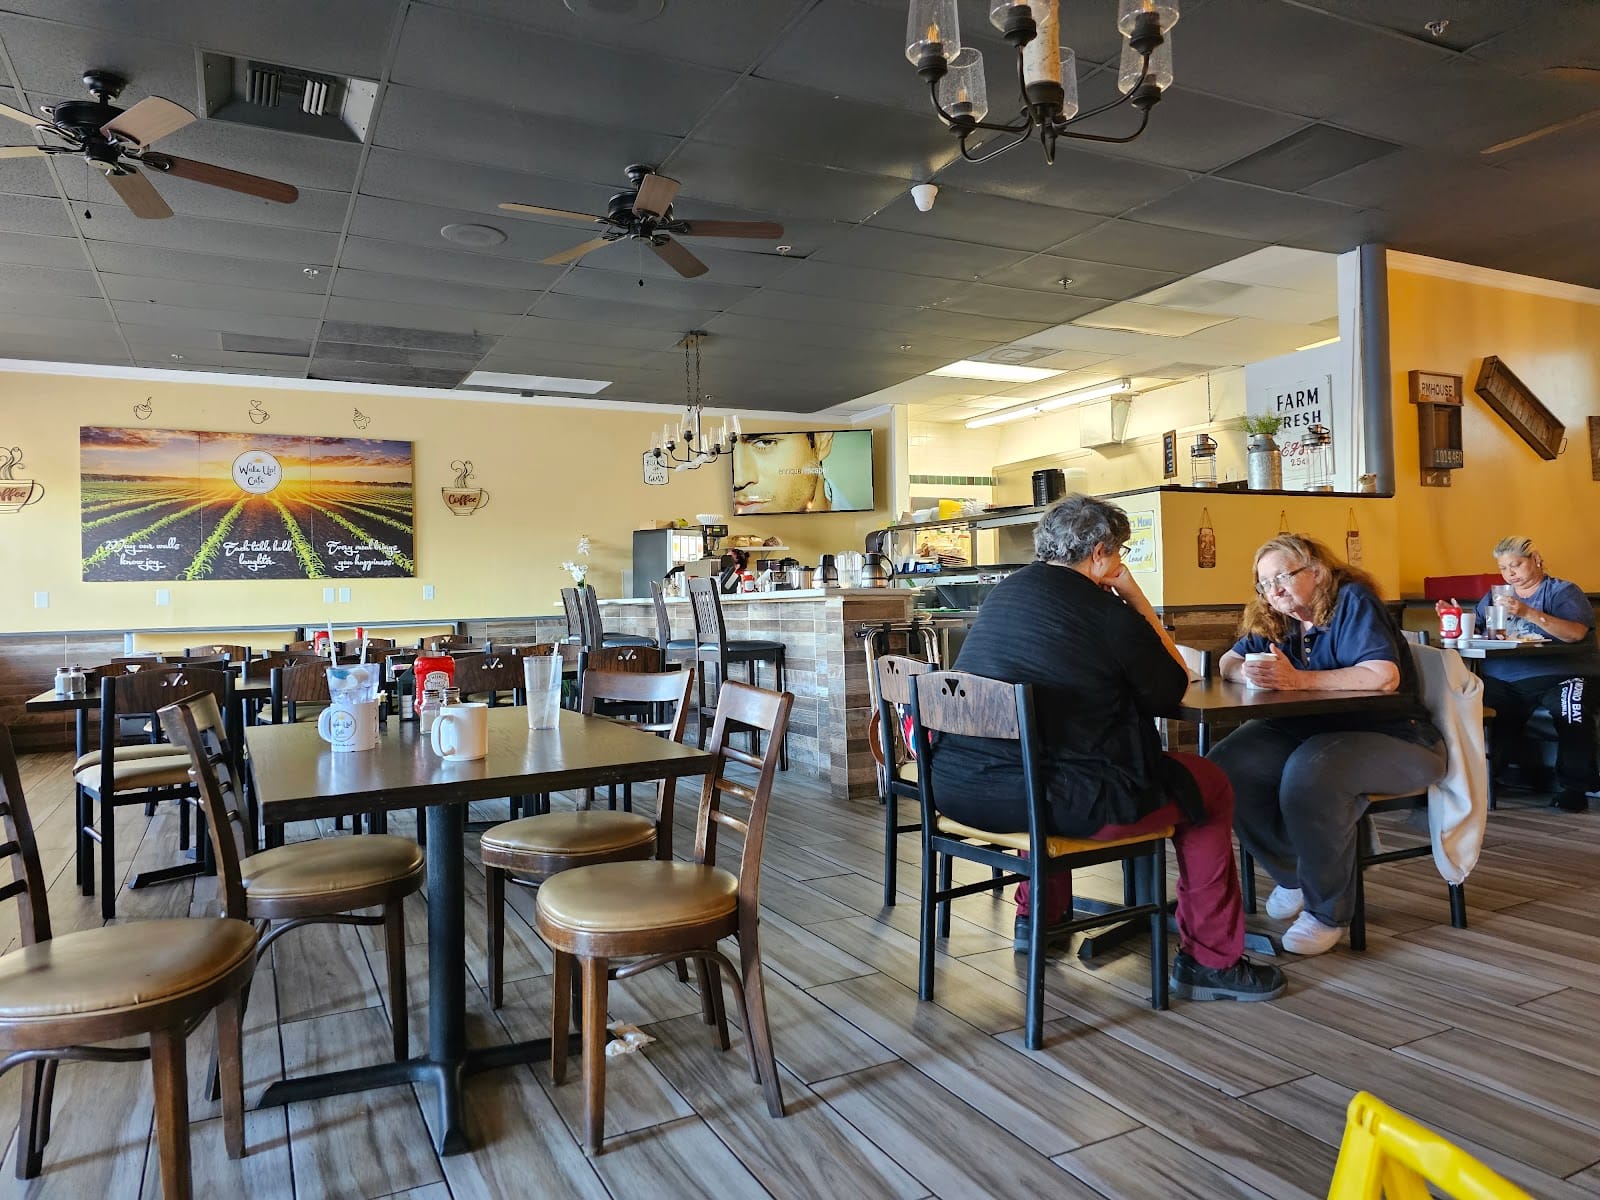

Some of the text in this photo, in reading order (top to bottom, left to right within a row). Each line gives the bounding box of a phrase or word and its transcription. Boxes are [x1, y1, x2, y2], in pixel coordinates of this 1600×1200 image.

[1277, 387, 1319, 411] FARM
[1283, 410, 1322, 428] RESH
[239, 463, 261, 475] Wake
[0, 487, 26, 501] ffee
[448, 494, 477, 506] Coffee
[1571, 703, 1583, 723] BAY
